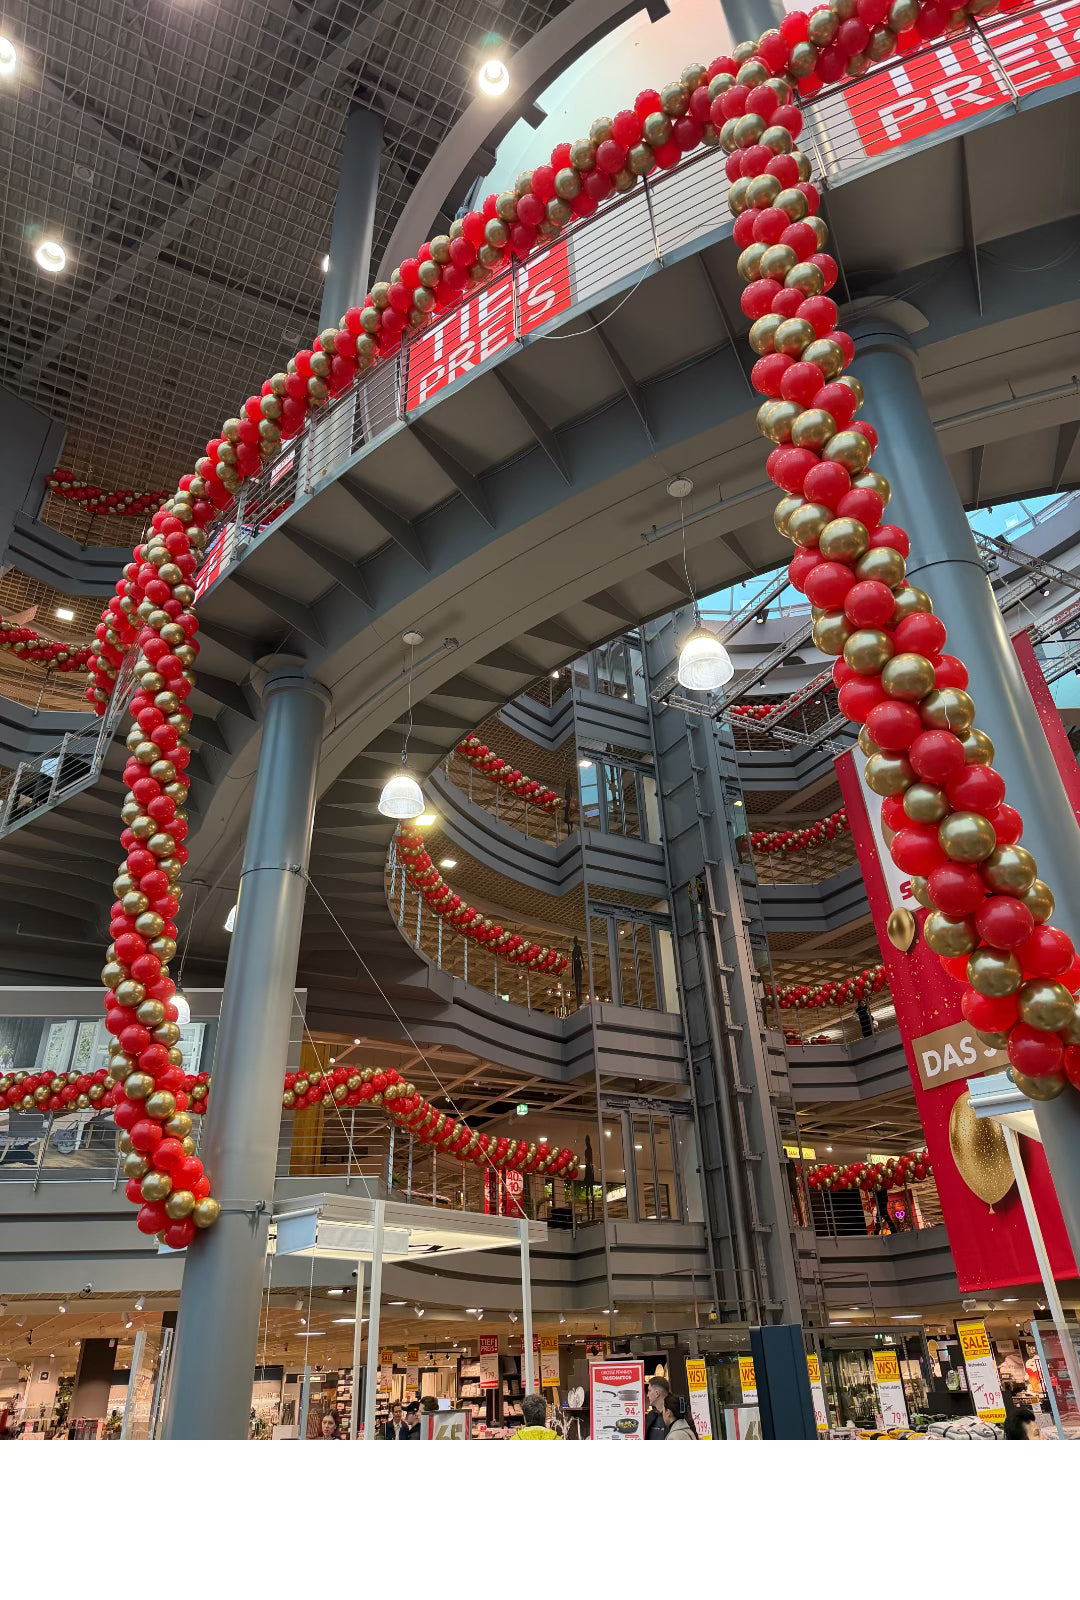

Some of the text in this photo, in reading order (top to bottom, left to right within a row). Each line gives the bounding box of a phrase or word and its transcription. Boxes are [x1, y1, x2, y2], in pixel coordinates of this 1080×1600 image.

[878, 33, 1080, 141] PREI
[419, 276, 556, 404] PRES
[922, 1036, 977, 1077] DAS
[541, 1339, 558, 1348] SALE
[962, 1335, 989, 1350] SALE
[742, 1368, 756, 1380] WS
[808, 1364, 819, 1375] SV
[876, 1361, 897, 1374] WSV
[688, 1370, 707, 1383] WSV
